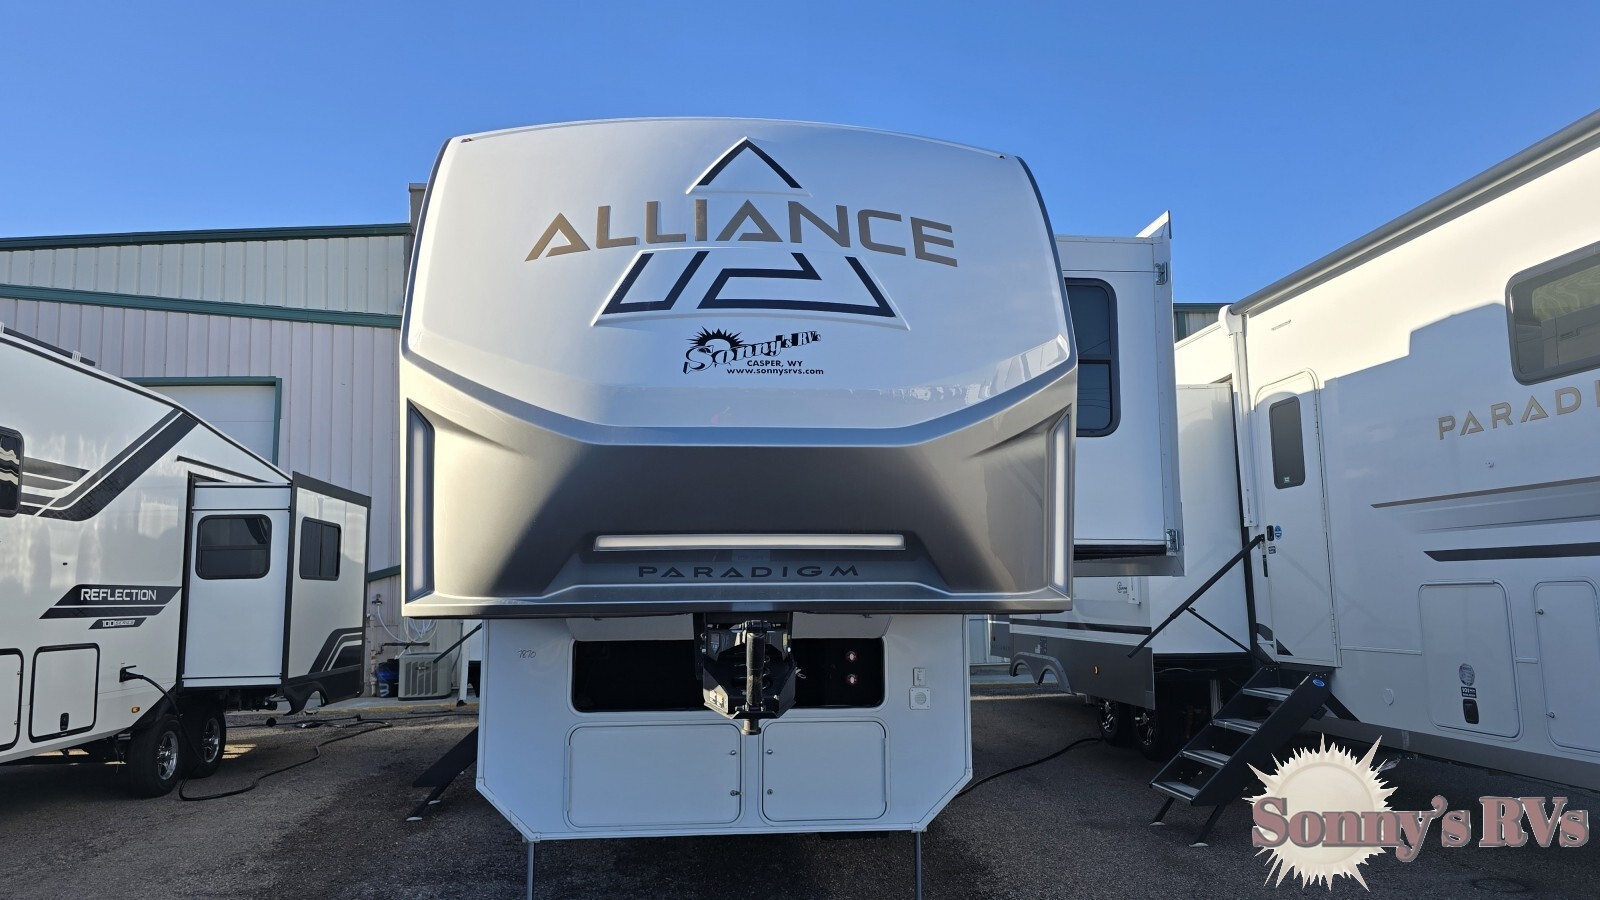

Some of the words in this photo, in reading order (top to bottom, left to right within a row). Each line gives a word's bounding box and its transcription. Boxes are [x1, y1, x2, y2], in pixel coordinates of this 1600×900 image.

[524, 199, 958, 268] ALLIANCE
[683, 335, 791, 375] Sonny's
[746, 360, 784, 368] CASPER,
[726, 368, 824, 376] www.sonnysrvs.com
[638, 565, 859, 578] PARADIGM
[80, 588, 157, 601] REFLECTION
